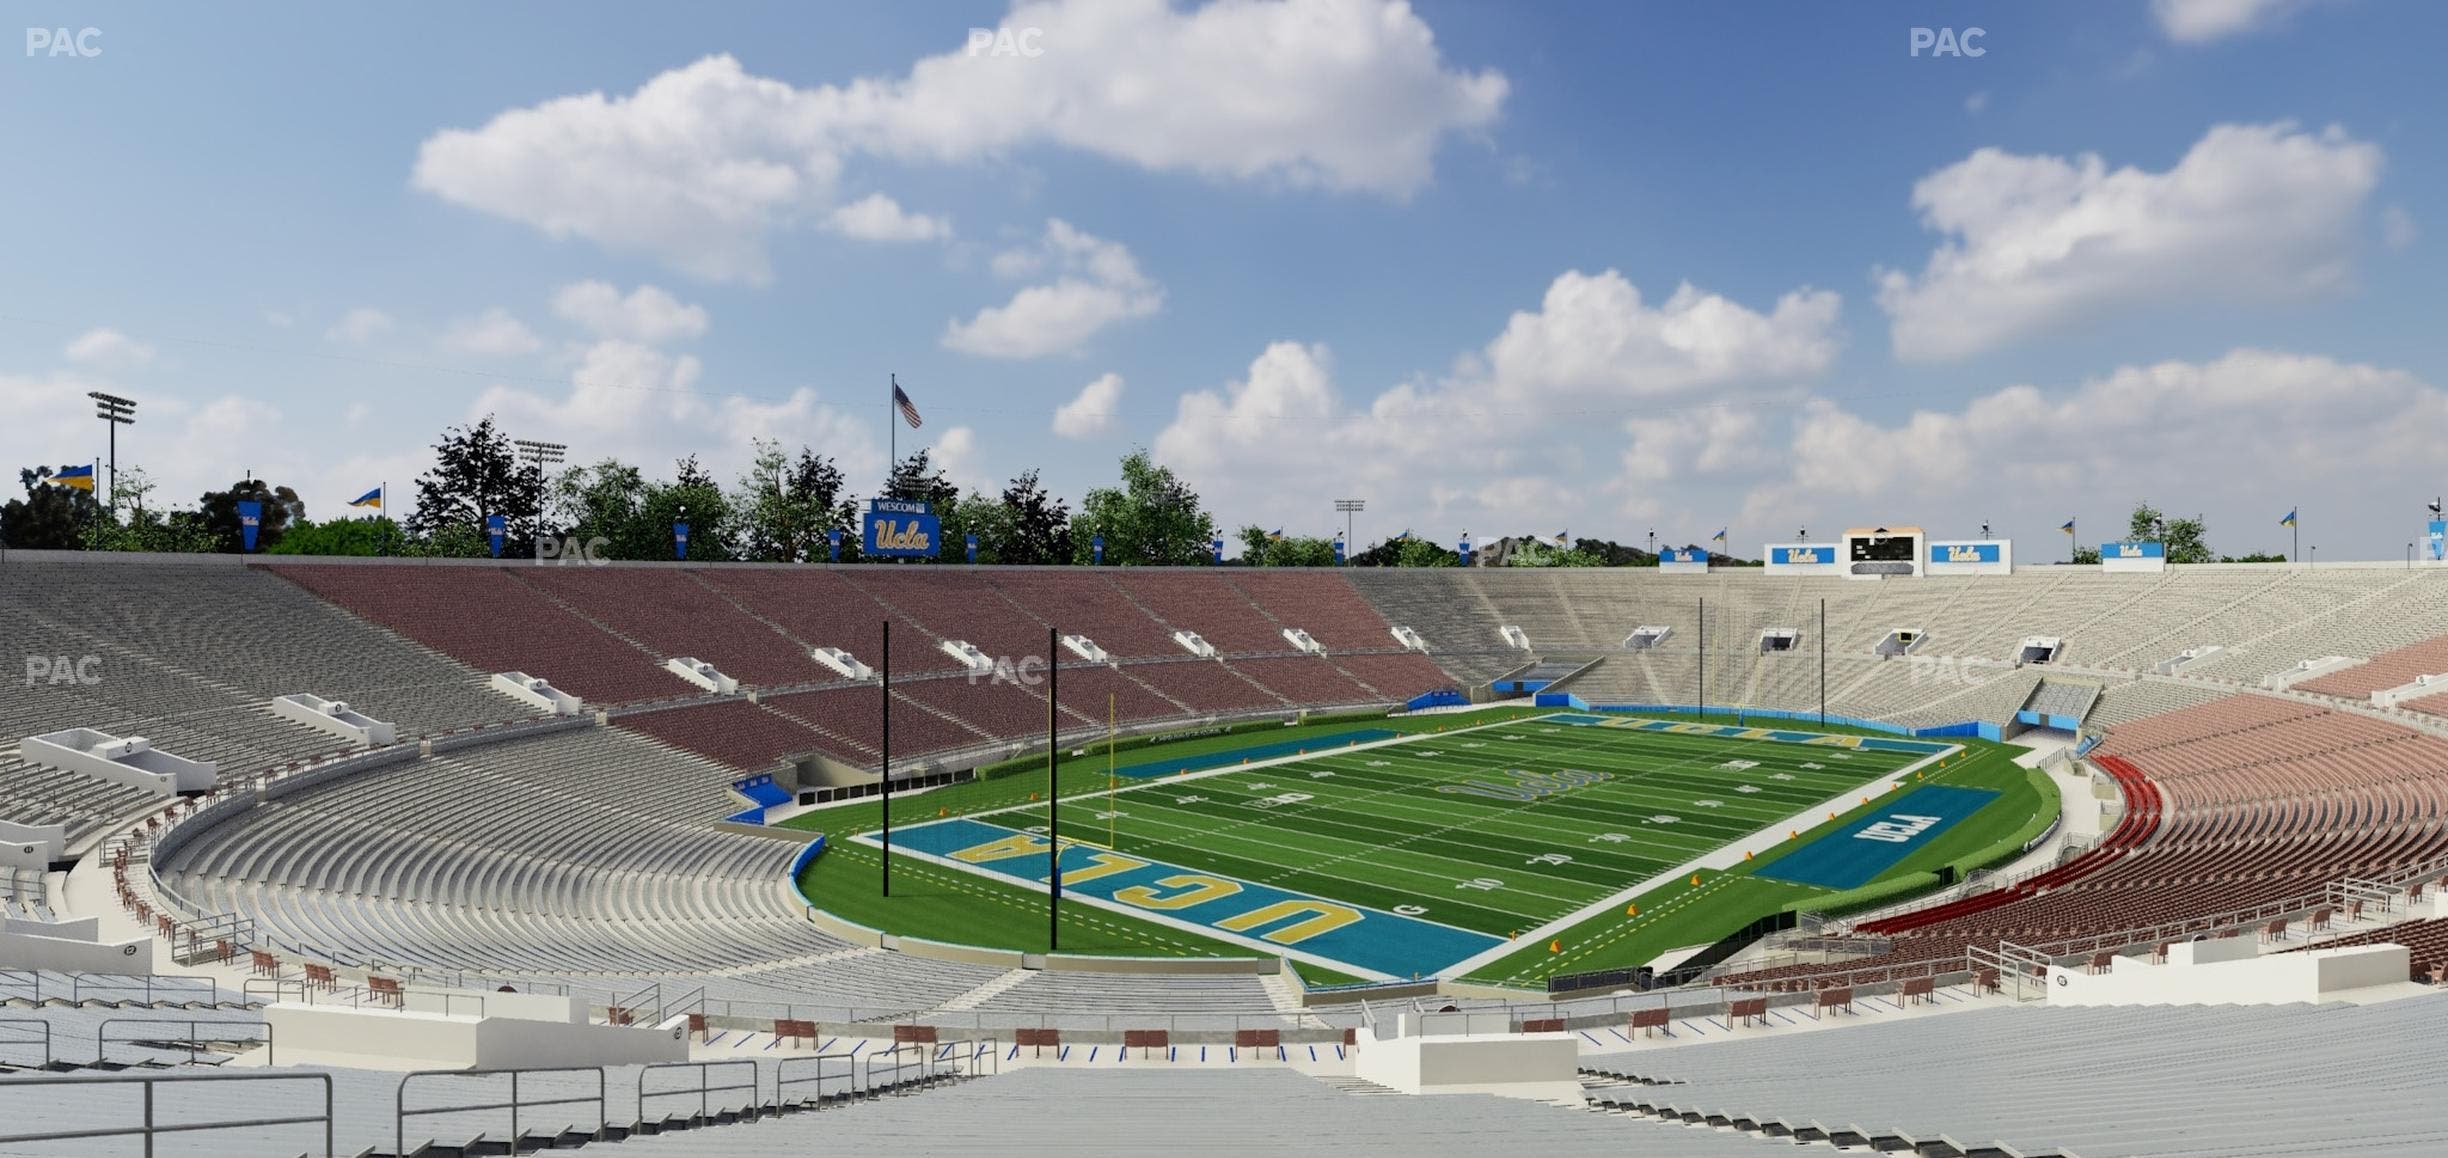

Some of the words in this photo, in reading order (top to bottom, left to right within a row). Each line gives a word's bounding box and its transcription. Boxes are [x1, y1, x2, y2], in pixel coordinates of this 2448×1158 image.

[876, 501, 915, 512] WESCOM
[875, 519, 930, 550] Ucla
[1852, 814, 1943, 842] UCLA
[945, 833, 1366, 946] UCLA
